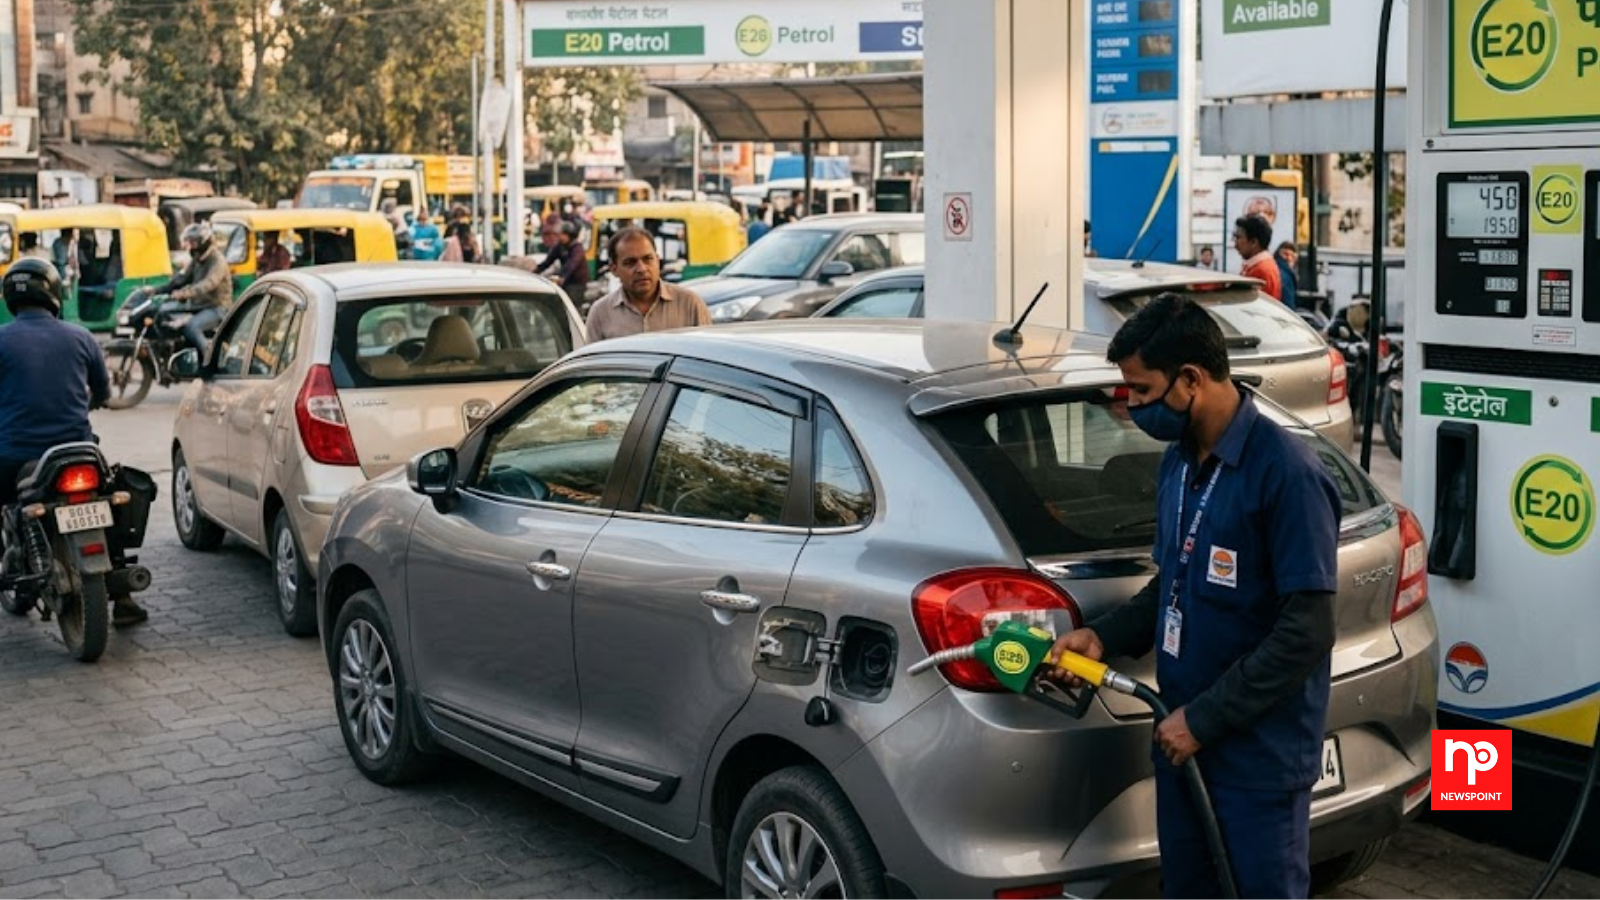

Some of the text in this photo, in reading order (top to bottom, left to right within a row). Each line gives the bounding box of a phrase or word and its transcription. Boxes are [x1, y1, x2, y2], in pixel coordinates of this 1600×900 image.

[1232, 0, 1319, 24] Available
[565, 31, 670, 53] E20 Petrol
[778, 25, 834, 44] Petrol
[1482, 21, 1546, 58] E20
[1577, 47, 1600, 77] P
[1480, 186, 1517, 210] 450
[1541, 192, 1572, 208] E20
[1484, 217, 1517, 234] 1950
[1525, 487, 1580, 522] E20
